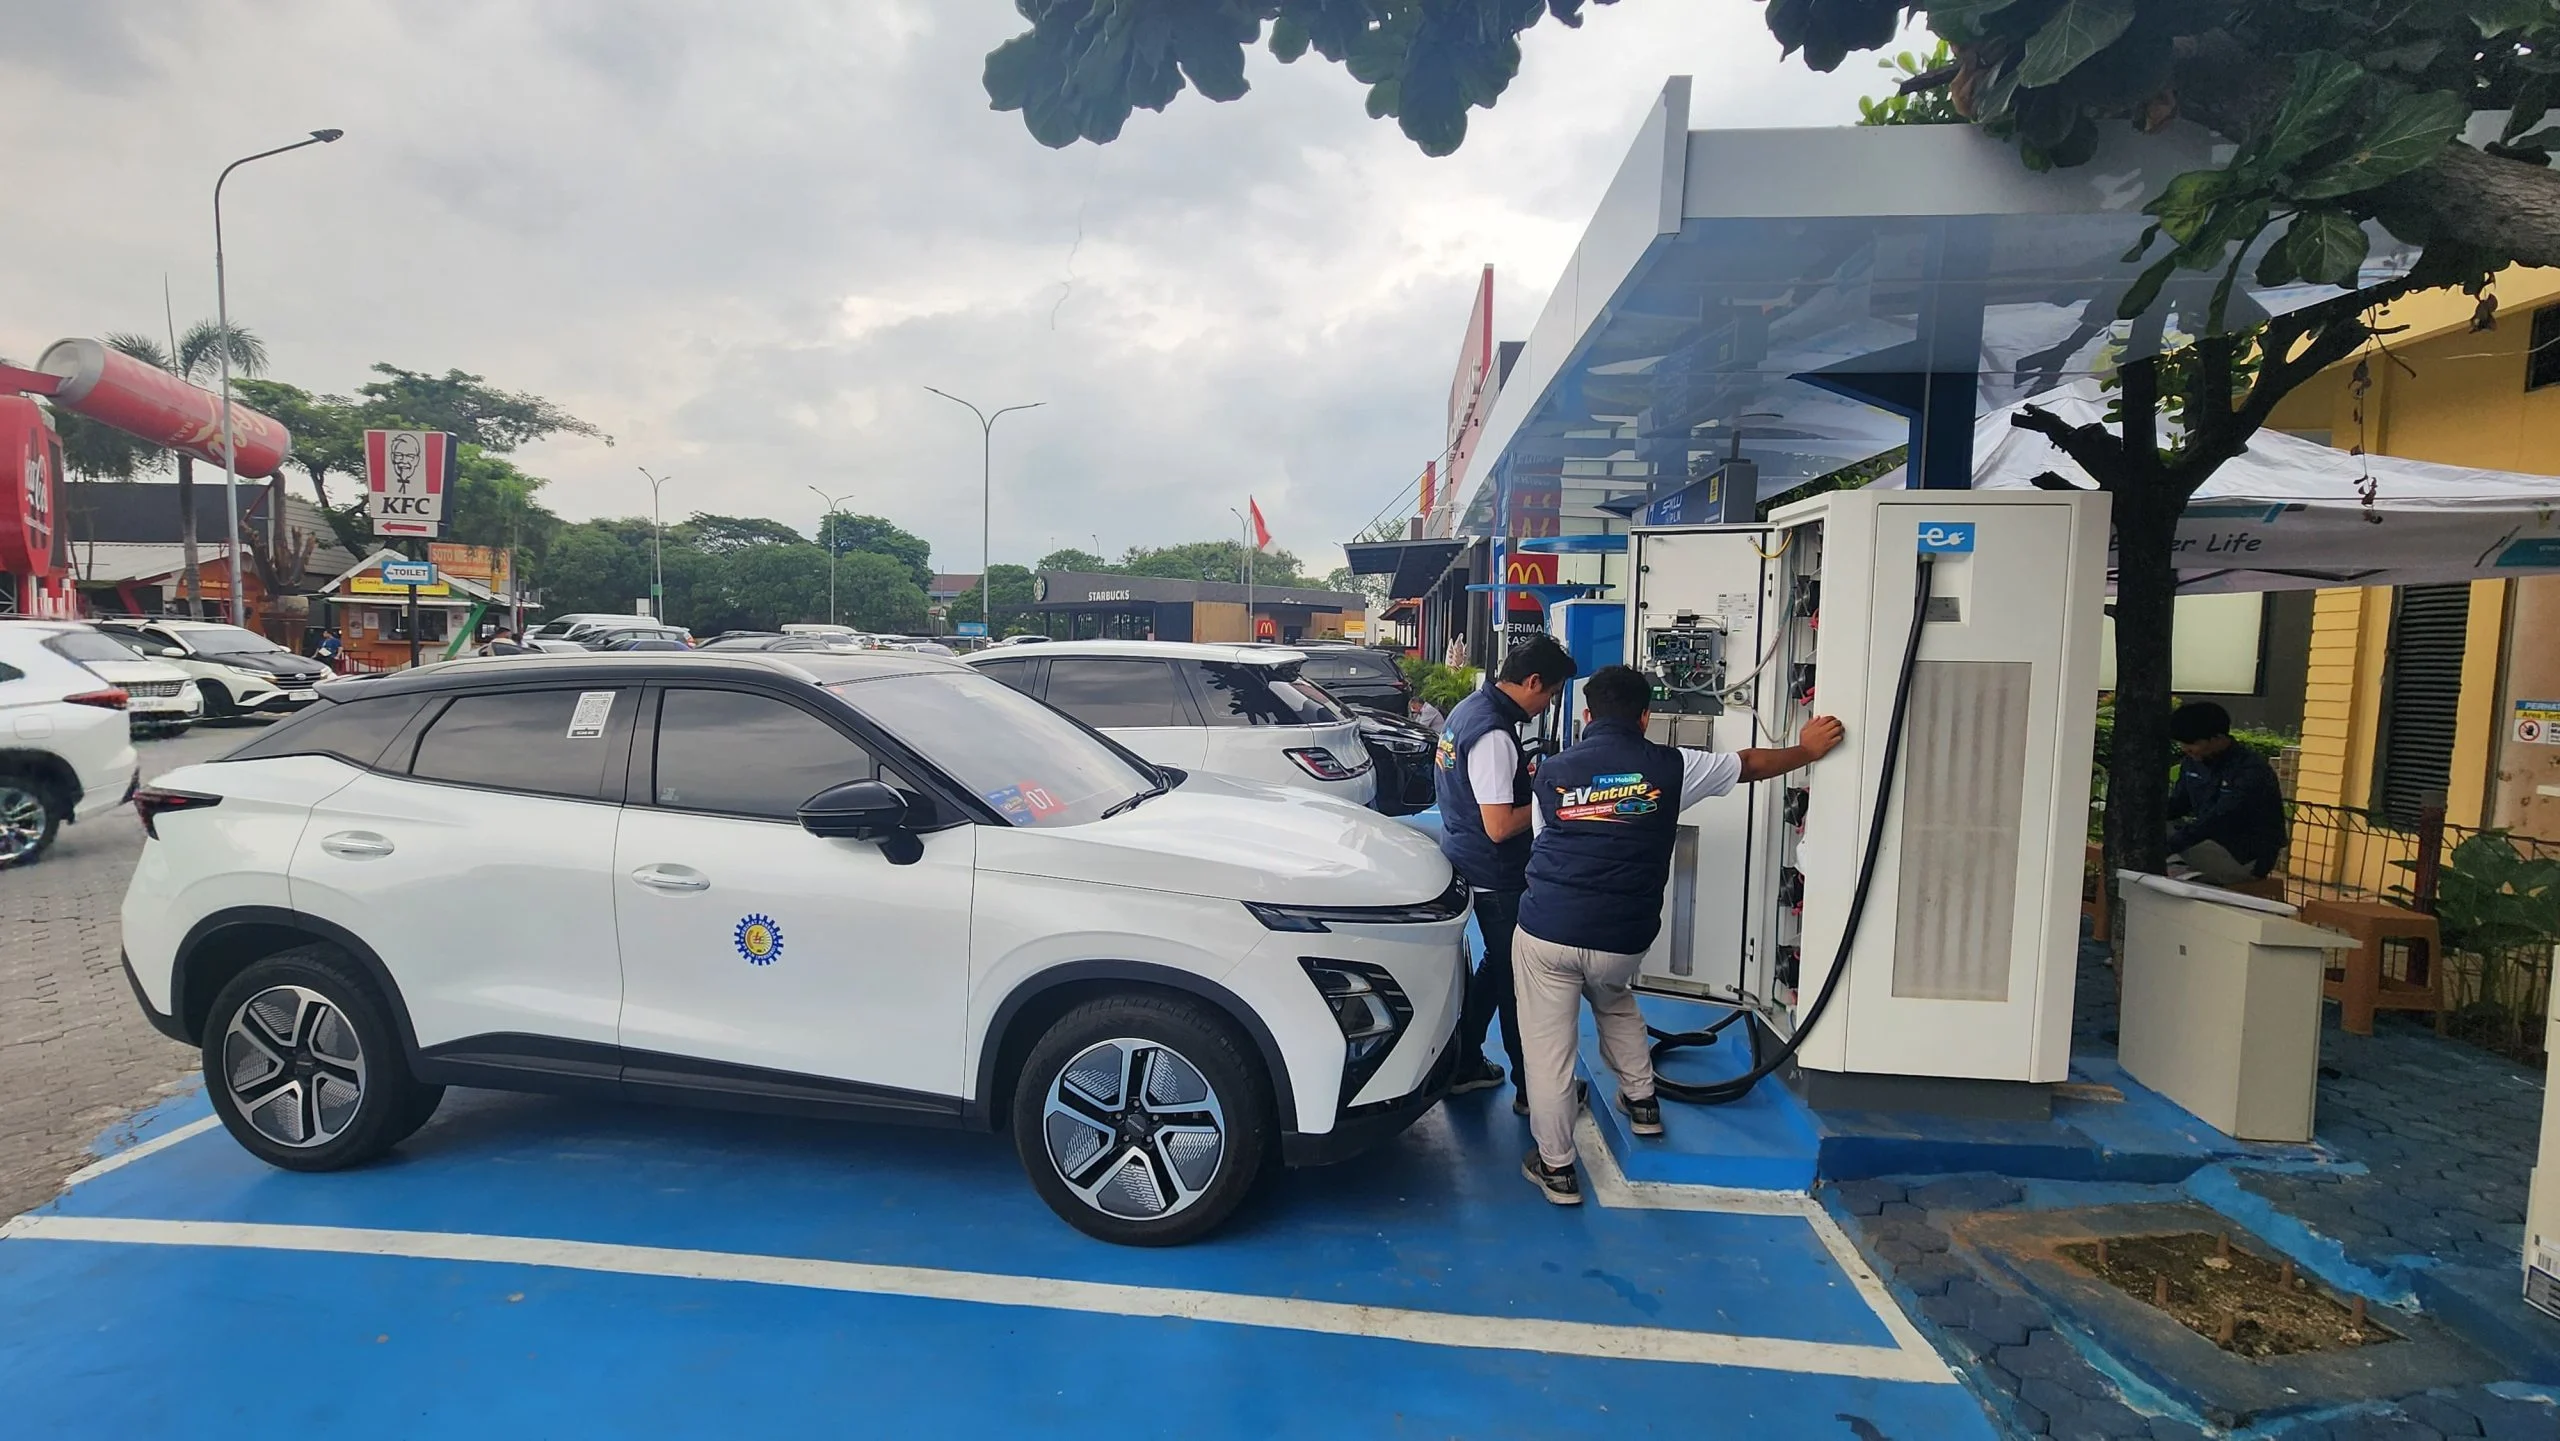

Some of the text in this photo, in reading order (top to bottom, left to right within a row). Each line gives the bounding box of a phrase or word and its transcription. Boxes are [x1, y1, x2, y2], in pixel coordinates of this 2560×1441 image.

[381, 497, 430, 515] KFC
[2206, 532, 2262, 553] Life
[393, 568, 428, 577] TOILET
[1088, 589, 1130, 602] STARBUCKS
[1506, 622, 1544, 634] ERIMA
[1025, 788, 1055, 810] 07
[1562, 783, 1648, 807] EVenture
